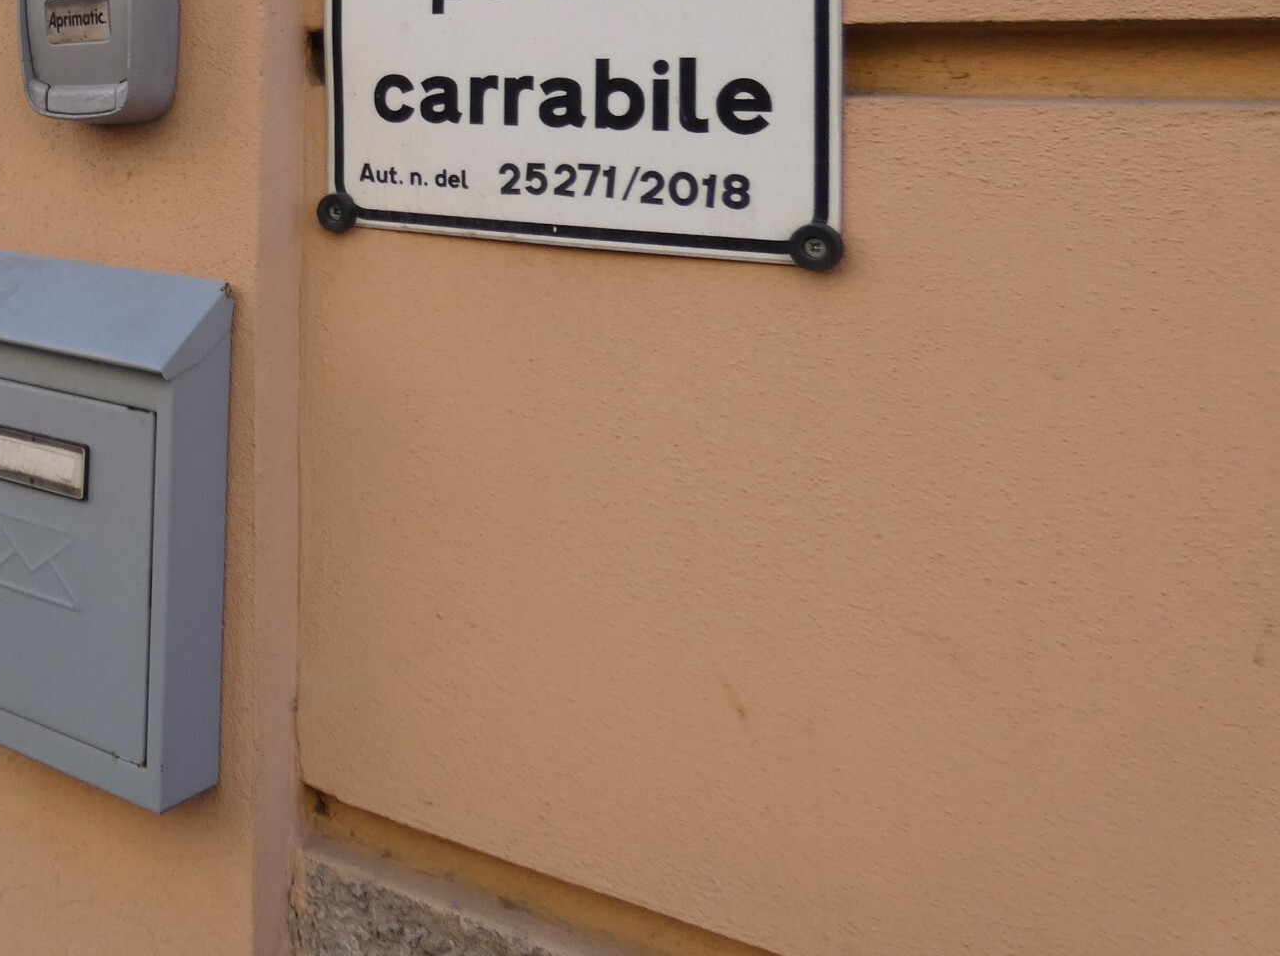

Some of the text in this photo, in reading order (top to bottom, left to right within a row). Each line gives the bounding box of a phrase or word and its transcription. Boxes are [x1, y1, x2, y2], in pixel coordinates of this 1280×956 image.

[372, 57, 773, 135] carrabile
[360, 162, 404, 186] Aut.
[409, 171, 429, 186] n.
[435, 169, 470, 190] del
